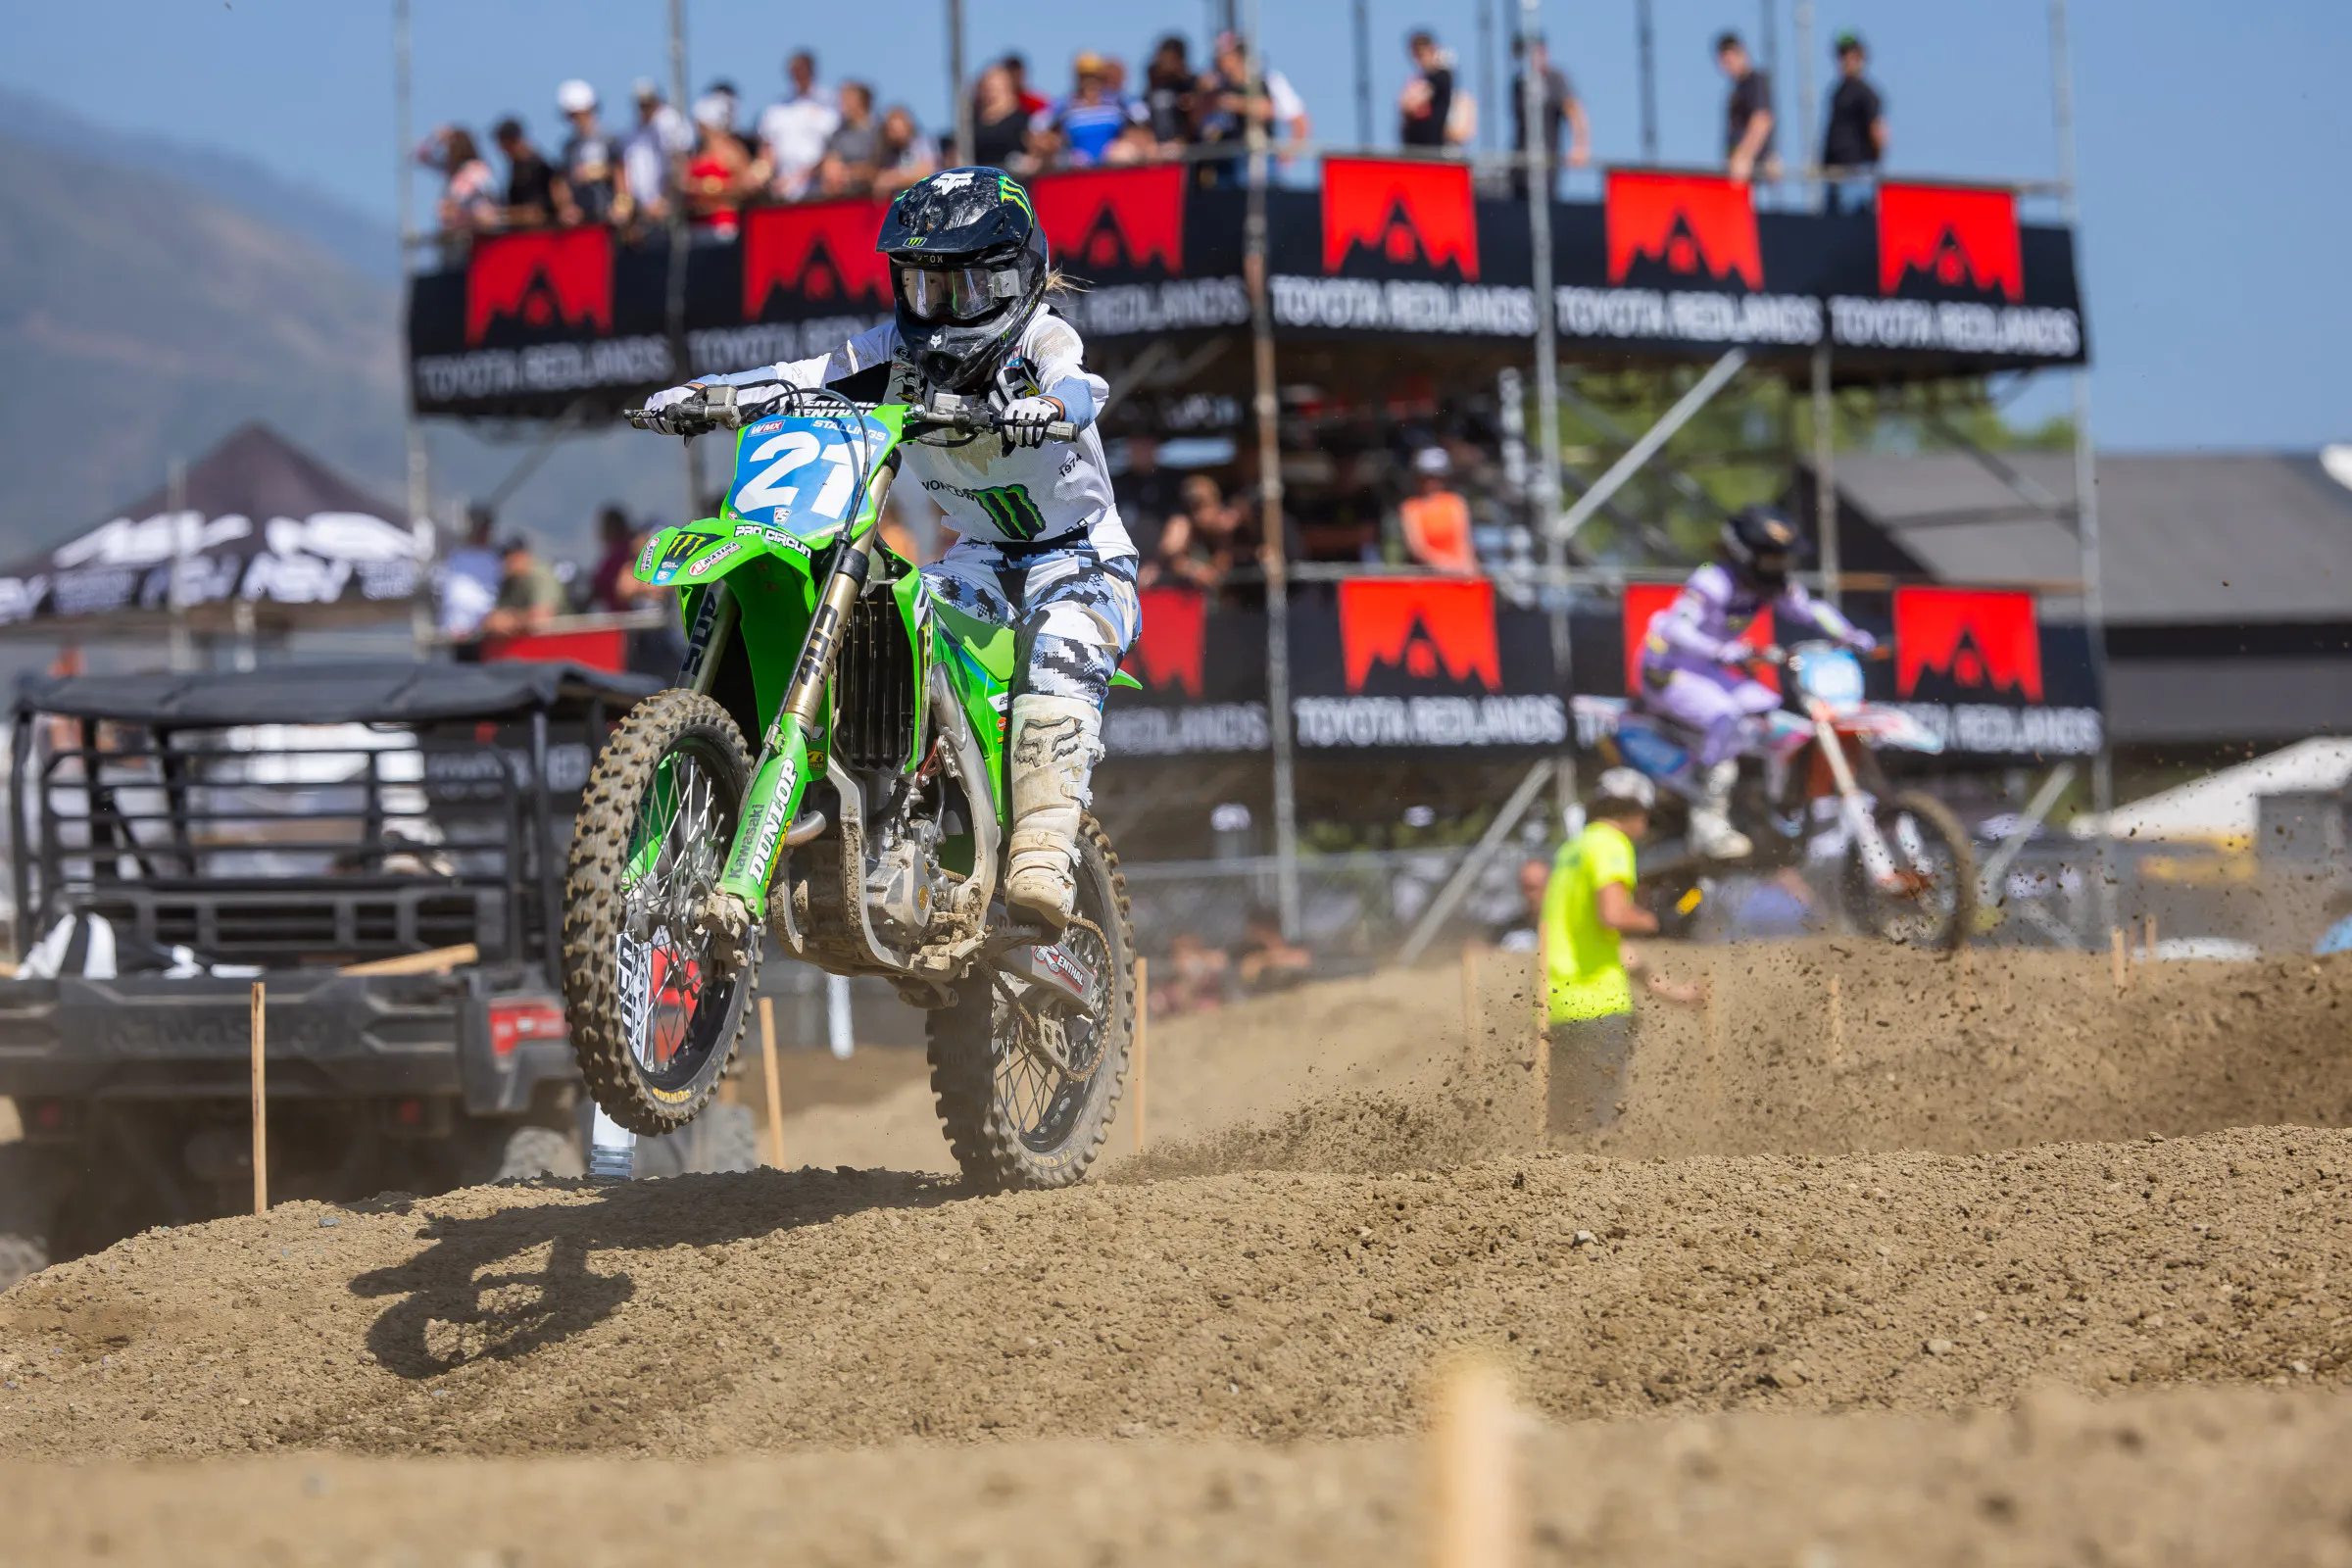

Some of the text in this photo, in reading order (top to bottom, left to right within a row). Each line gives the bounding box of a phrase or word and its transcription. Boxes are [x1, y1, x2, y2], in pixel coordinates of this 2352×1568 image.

[1269, 274, 1538, 336] TOYOTA REDLANDS
[1555, 284, 1824, 345] TOYOTA REDLANDS
[1828, 295, 2080, 357] TOYOTA REDLANDS
[751, 420, 784, 436] WMX
[734, 431, 878, 520] 21
[1059, 453, 1083, 477] 1974
[735, 525, 763, 537] PRO
[1293, 696, 1408, 747] TOYOTA
[1409, 694, 1567, 747] REDLANDS
[728, 804, 765, 879] Kawasaki
[748, 757, 798, 887] DUNLOP
[1034, 944, 1085, 986] RENTHAL
